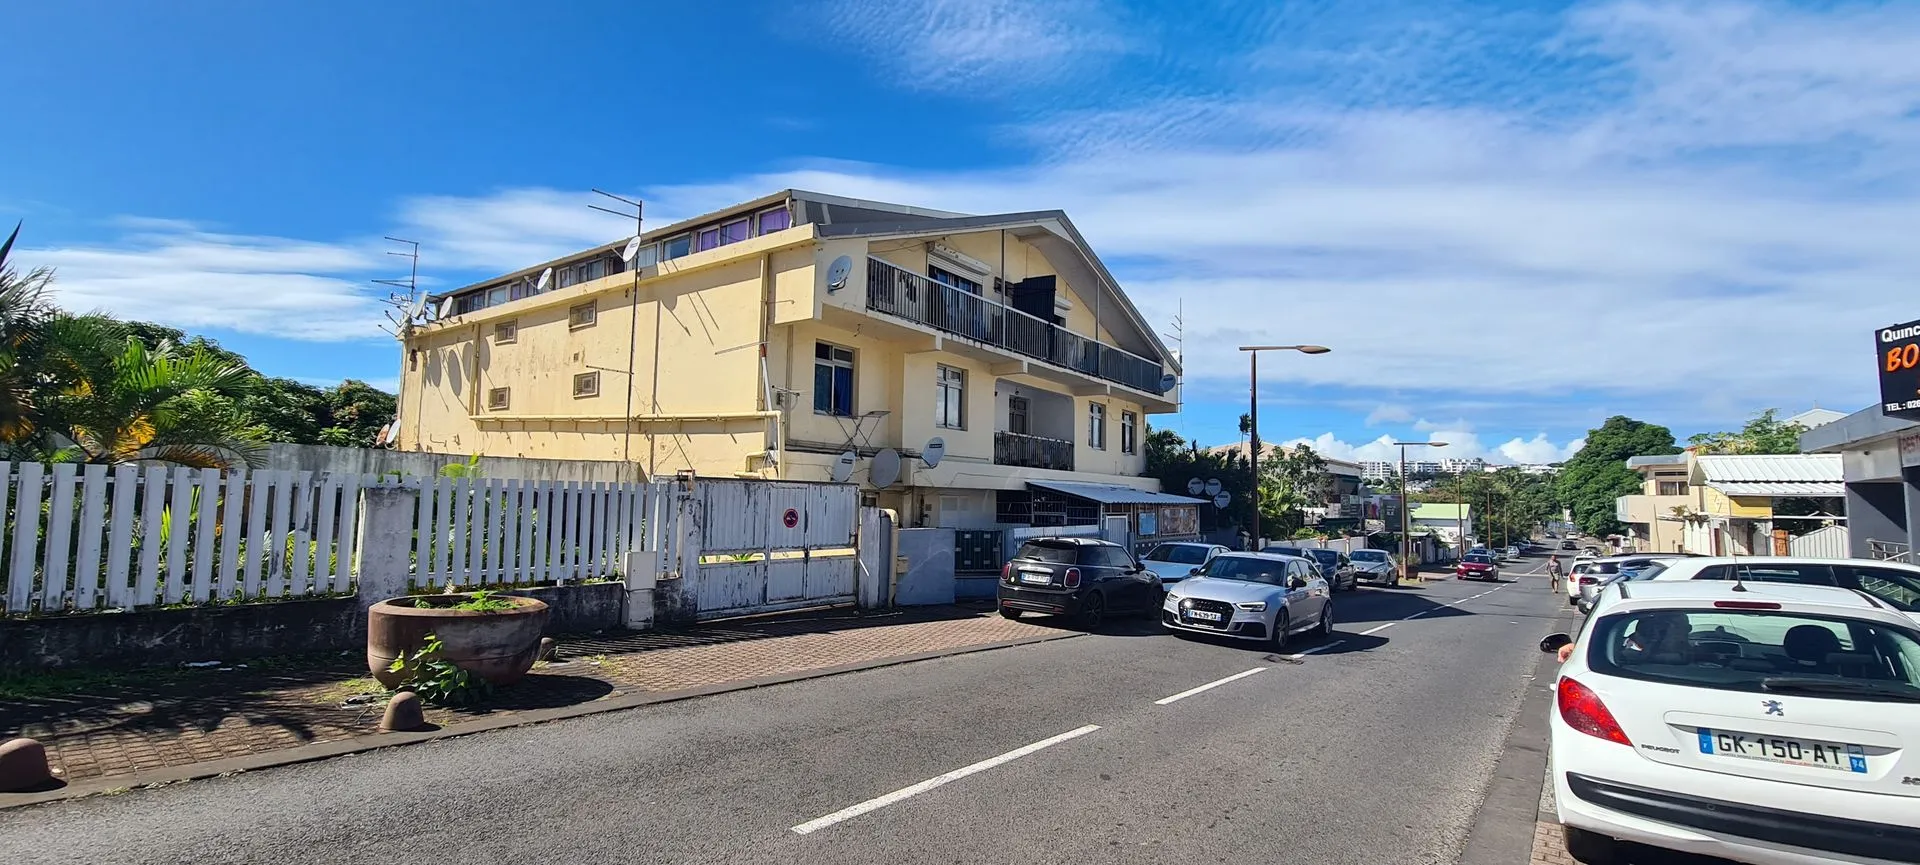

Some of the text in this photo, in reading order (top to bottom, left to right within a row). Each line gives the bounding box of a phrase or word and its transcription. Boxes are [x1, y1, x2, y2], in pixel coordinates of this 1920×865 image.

[1887, 343, 1920, 372] BO
[1641, 743, 1680, 754] PEUGEOT
[1717, 733, 1841, 765] GK-150-AT
